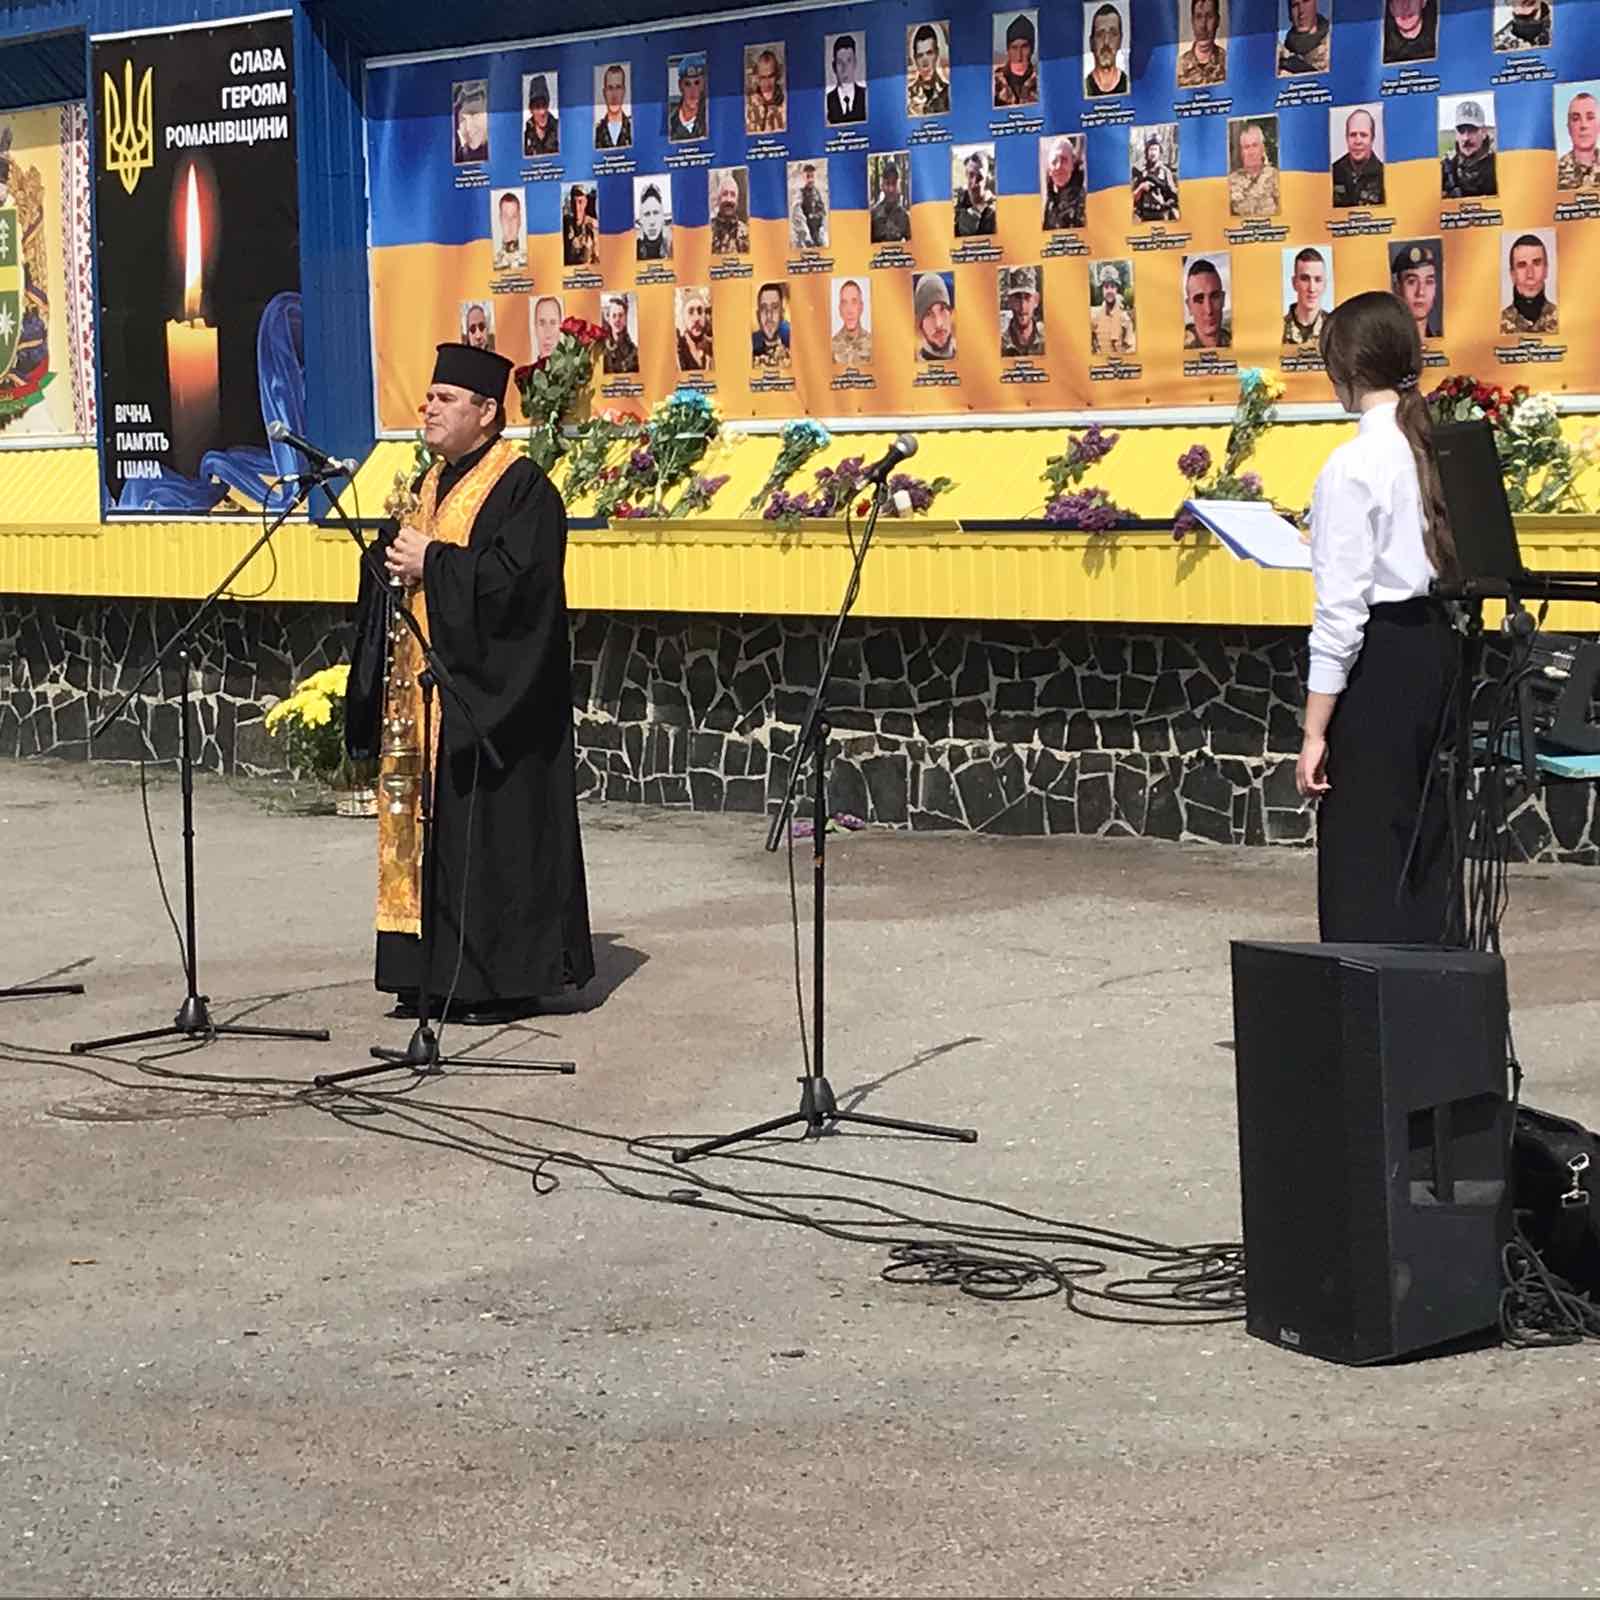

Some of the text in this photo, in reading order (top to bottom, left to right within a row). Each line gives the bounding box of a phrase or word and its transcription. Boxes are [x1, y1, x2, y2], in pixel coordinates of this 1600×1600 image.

[230, 47, 287, 75] СЛАВА
[222, 81, 287, 110] ГЕРОЯМ
[165, 116, 288, 150] РОМАНІВЩИНИ
[115, 404, 152, 423] ВІЧНА
[117, 460, 162, 479] І ШАНА
